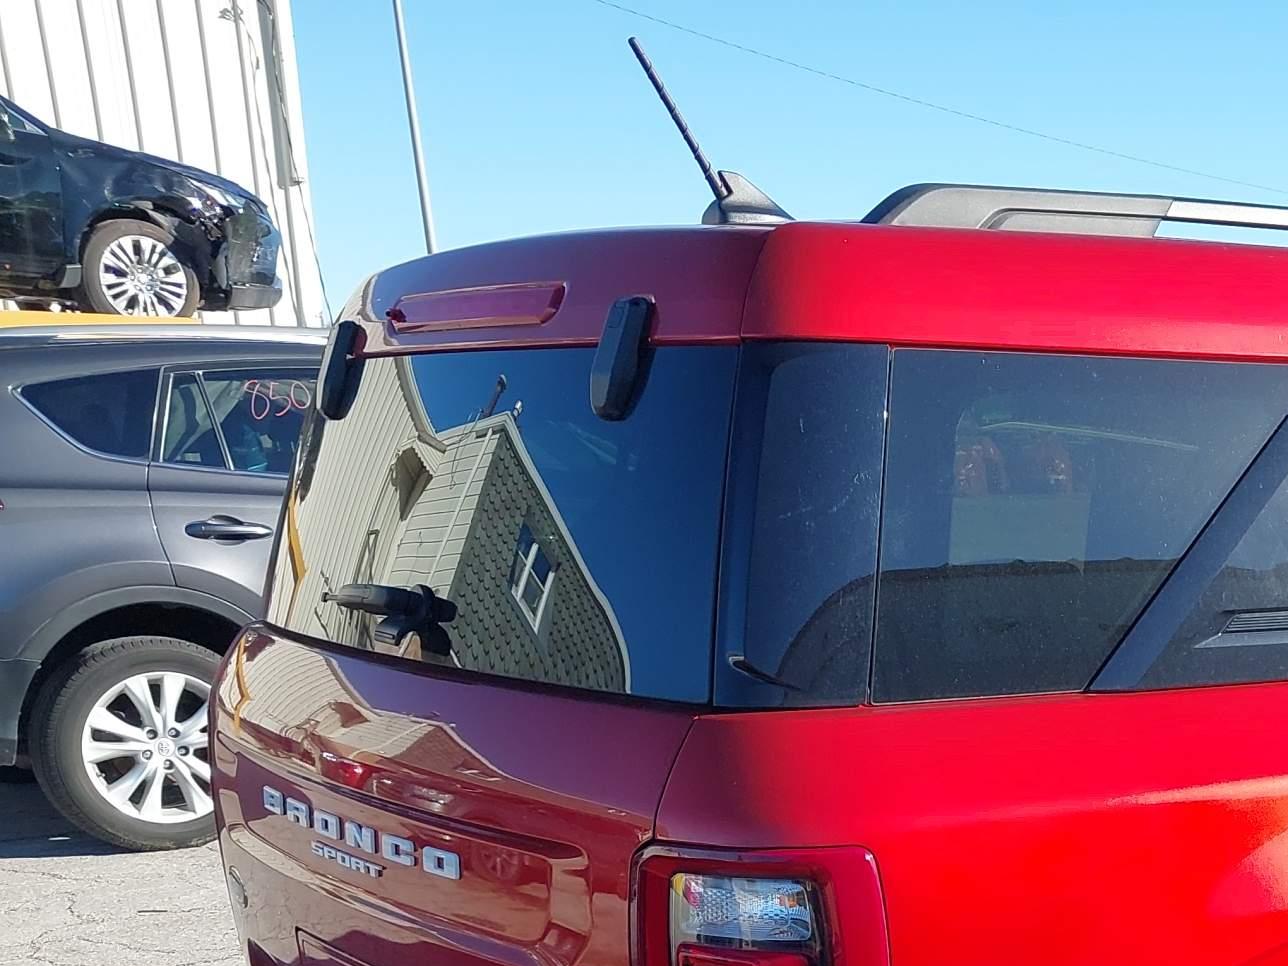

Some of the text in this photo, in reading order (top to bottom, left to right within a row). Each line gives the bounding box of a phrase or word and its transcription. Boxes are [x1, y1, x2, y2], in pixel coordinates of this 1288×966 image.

[243, 379, 312, 420] 850
[262, 784, 463, 881] BRONCO
[310, 840, 388, 880] SPORT
